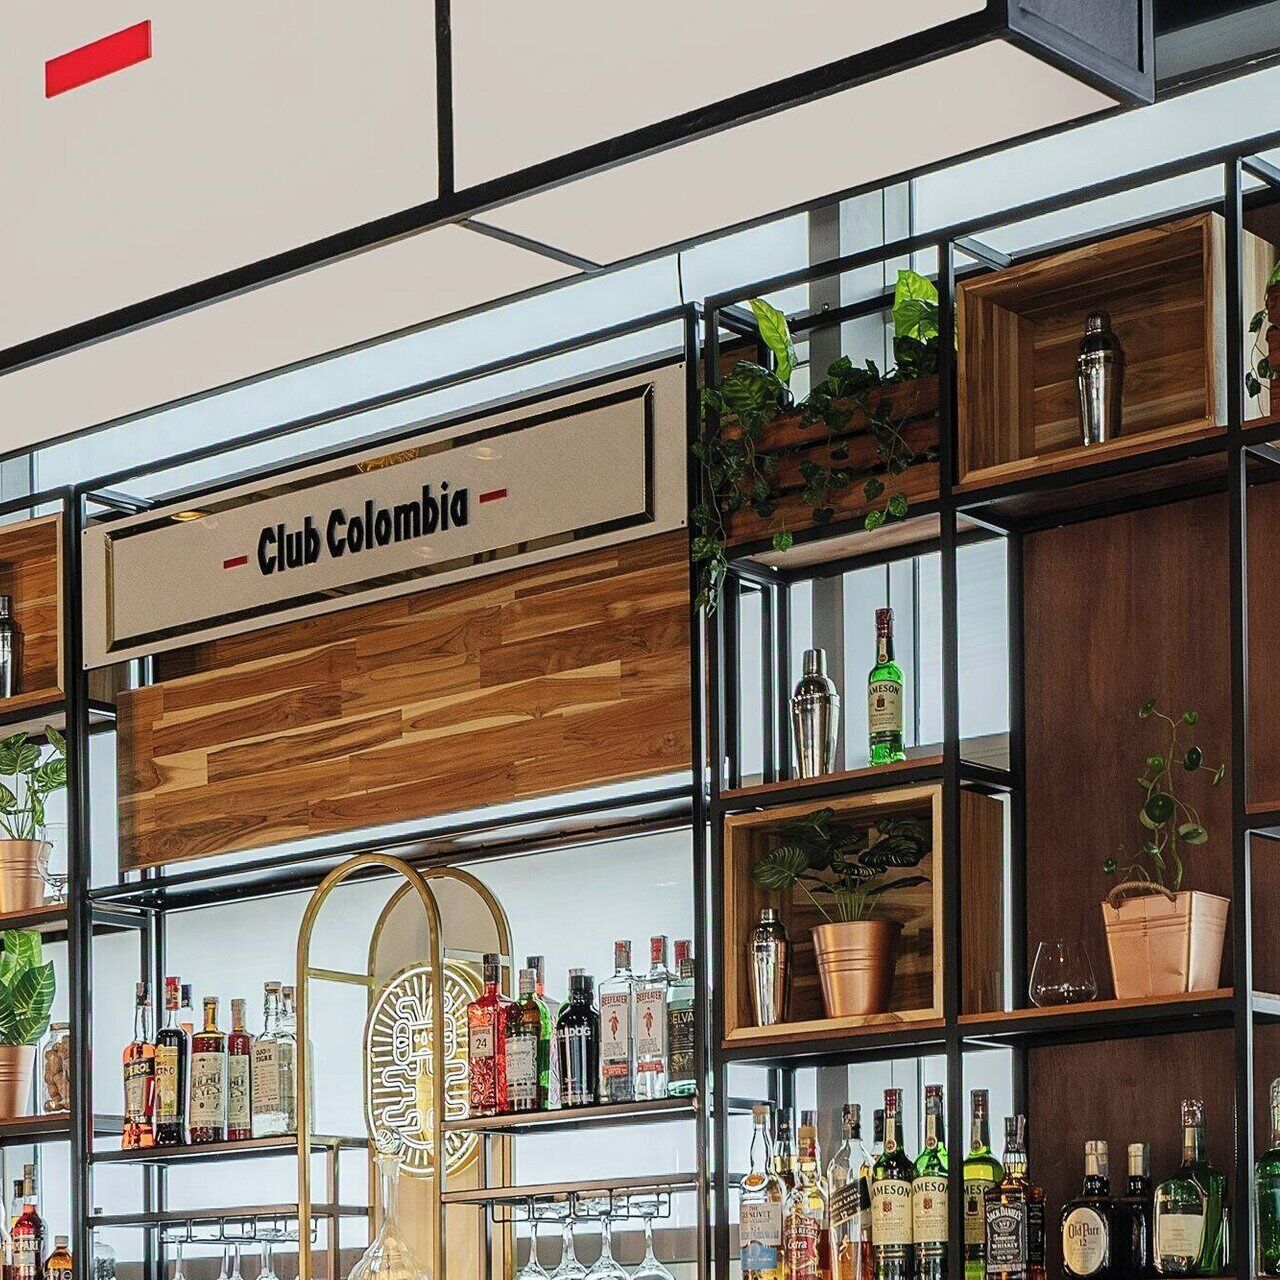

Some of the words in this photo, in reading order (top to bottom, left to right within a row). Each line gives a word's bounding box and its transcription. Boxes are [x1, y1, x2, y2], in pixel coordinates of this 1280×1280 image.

[258, 516, 321, 575] Club
[327, 481, 469, 558] Colombia
[602, 995, 628, 1007] BEEFEATER
[637, 990, 662, 1004] BEEFEATER
[476, 1038, 487, 1049] 24
[1068, 1223, 1082, 1238] Old
[1082, 1223, 1099, 1236] Parr
[1079, 1239, 1087, 1247] 12
